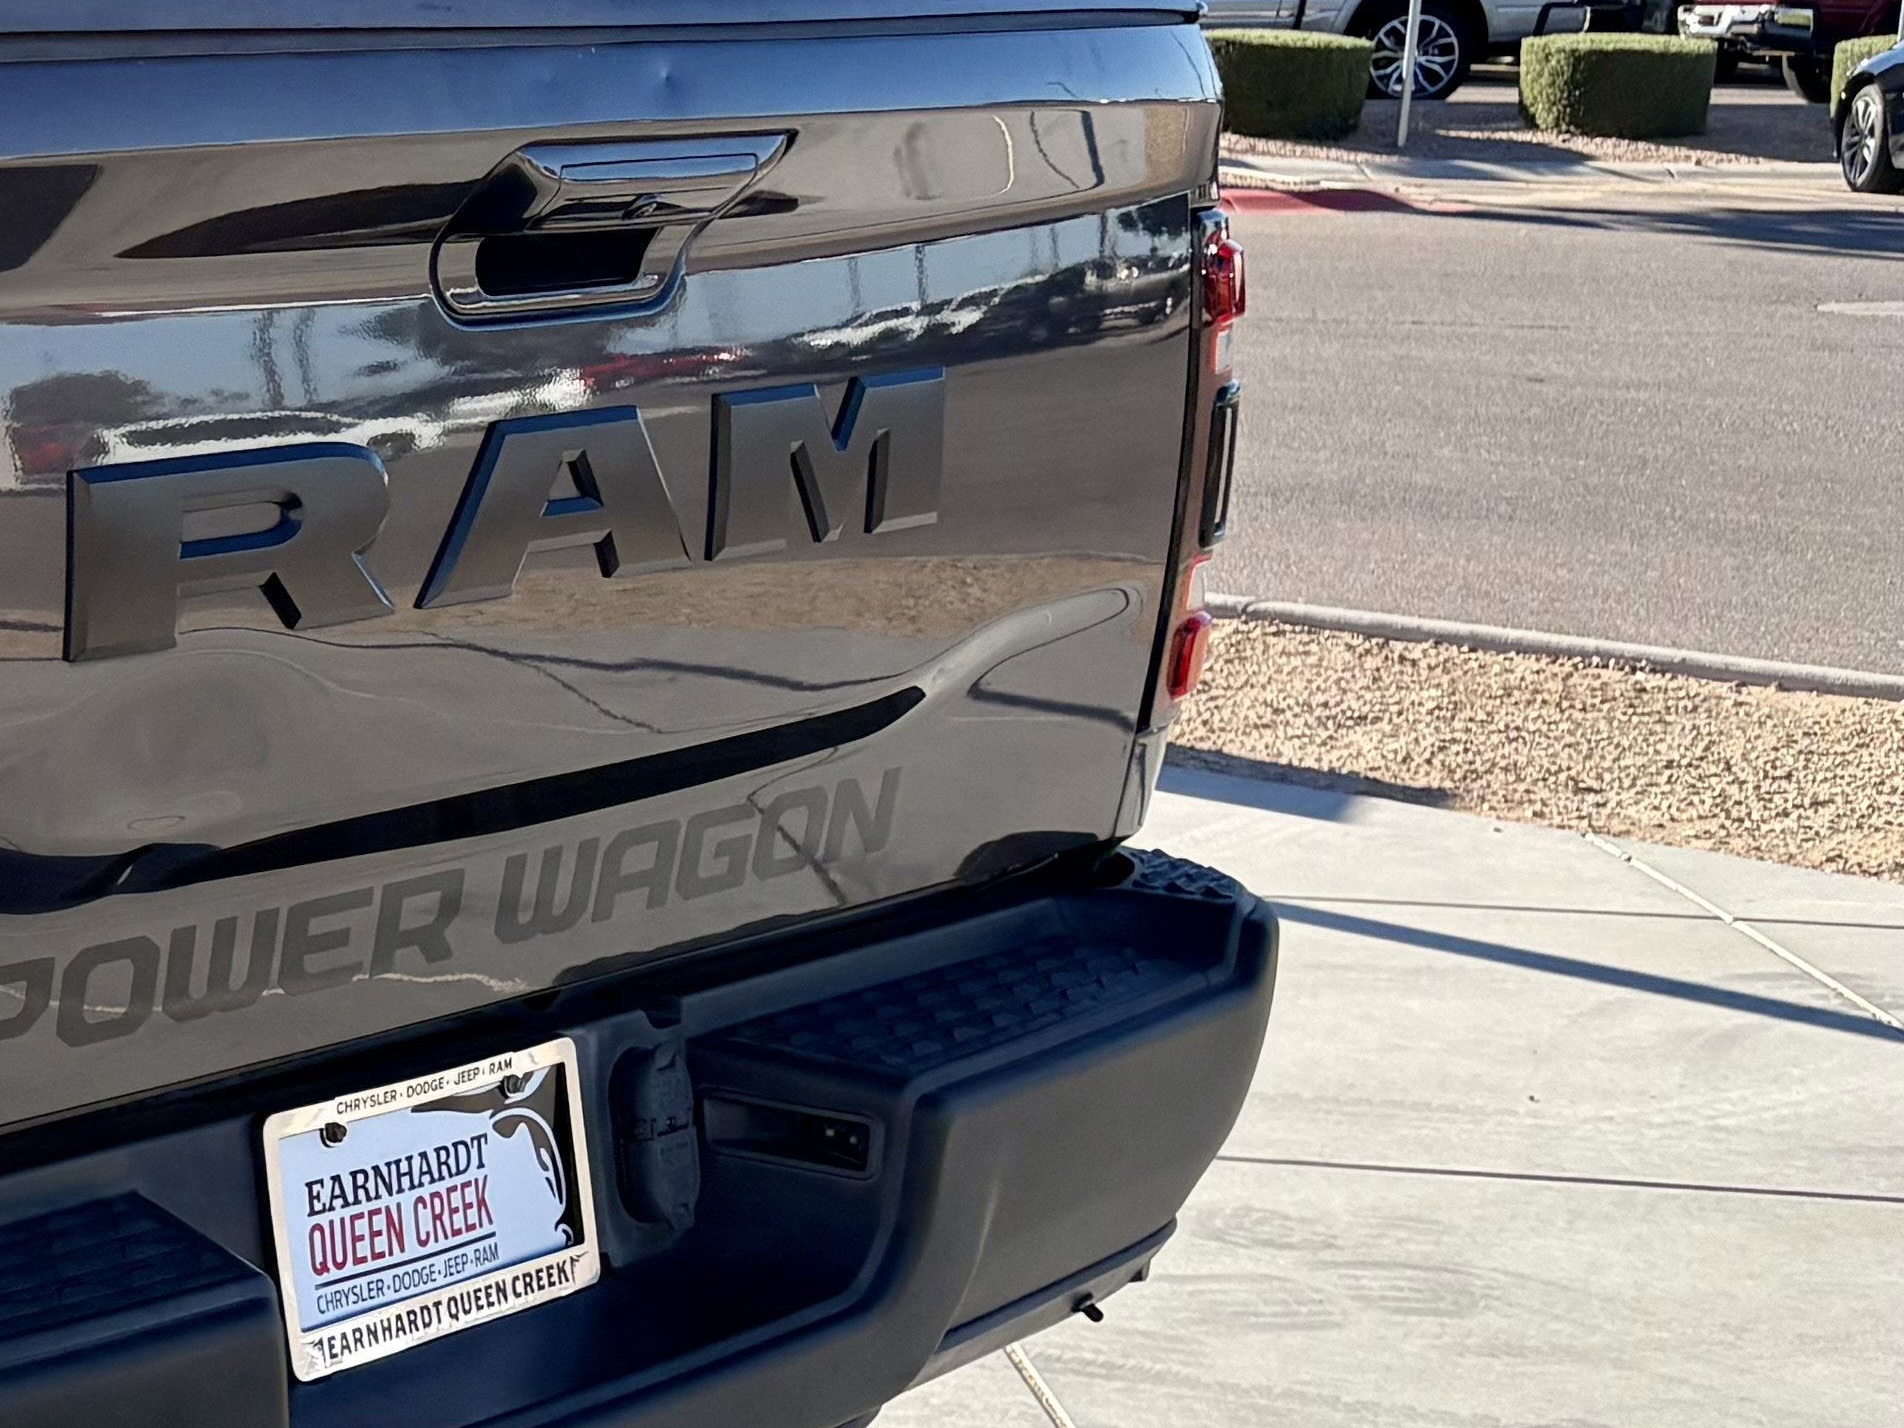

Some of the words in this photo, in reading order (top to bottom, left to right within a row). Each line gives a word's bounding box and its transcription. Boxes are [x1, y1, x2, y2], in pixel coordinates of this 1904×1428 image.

[64, 366, 946, 662] RAM
[494, 766, 902, 946] WAGON
[336, 1090, 398, 1115] CHRYSLER
[406, 1076, 445, 1100] DODGE
[454, 1067, 481, 1086] JEEP
[489, 1057, 513, 1076] RAM
[305, 1132, 489, 1218] EARNHARDT
[308, 1201, 406, 1277] QUEEN
[413, 1174, 494, 1248] CREEK
[316, 1280, 385, 1315] CHRYSLER
[392, 1265, 438, 1295] DODGE
[442, 1256, 468, 1280] JEEP
[474, 1242, 499, 1268] RAM
[327, 1299, 443, 1361] EARNHARDT
[447, 1279, 509, 1321] QUEEN
[511, 1262, 571, 1299] CREEK
